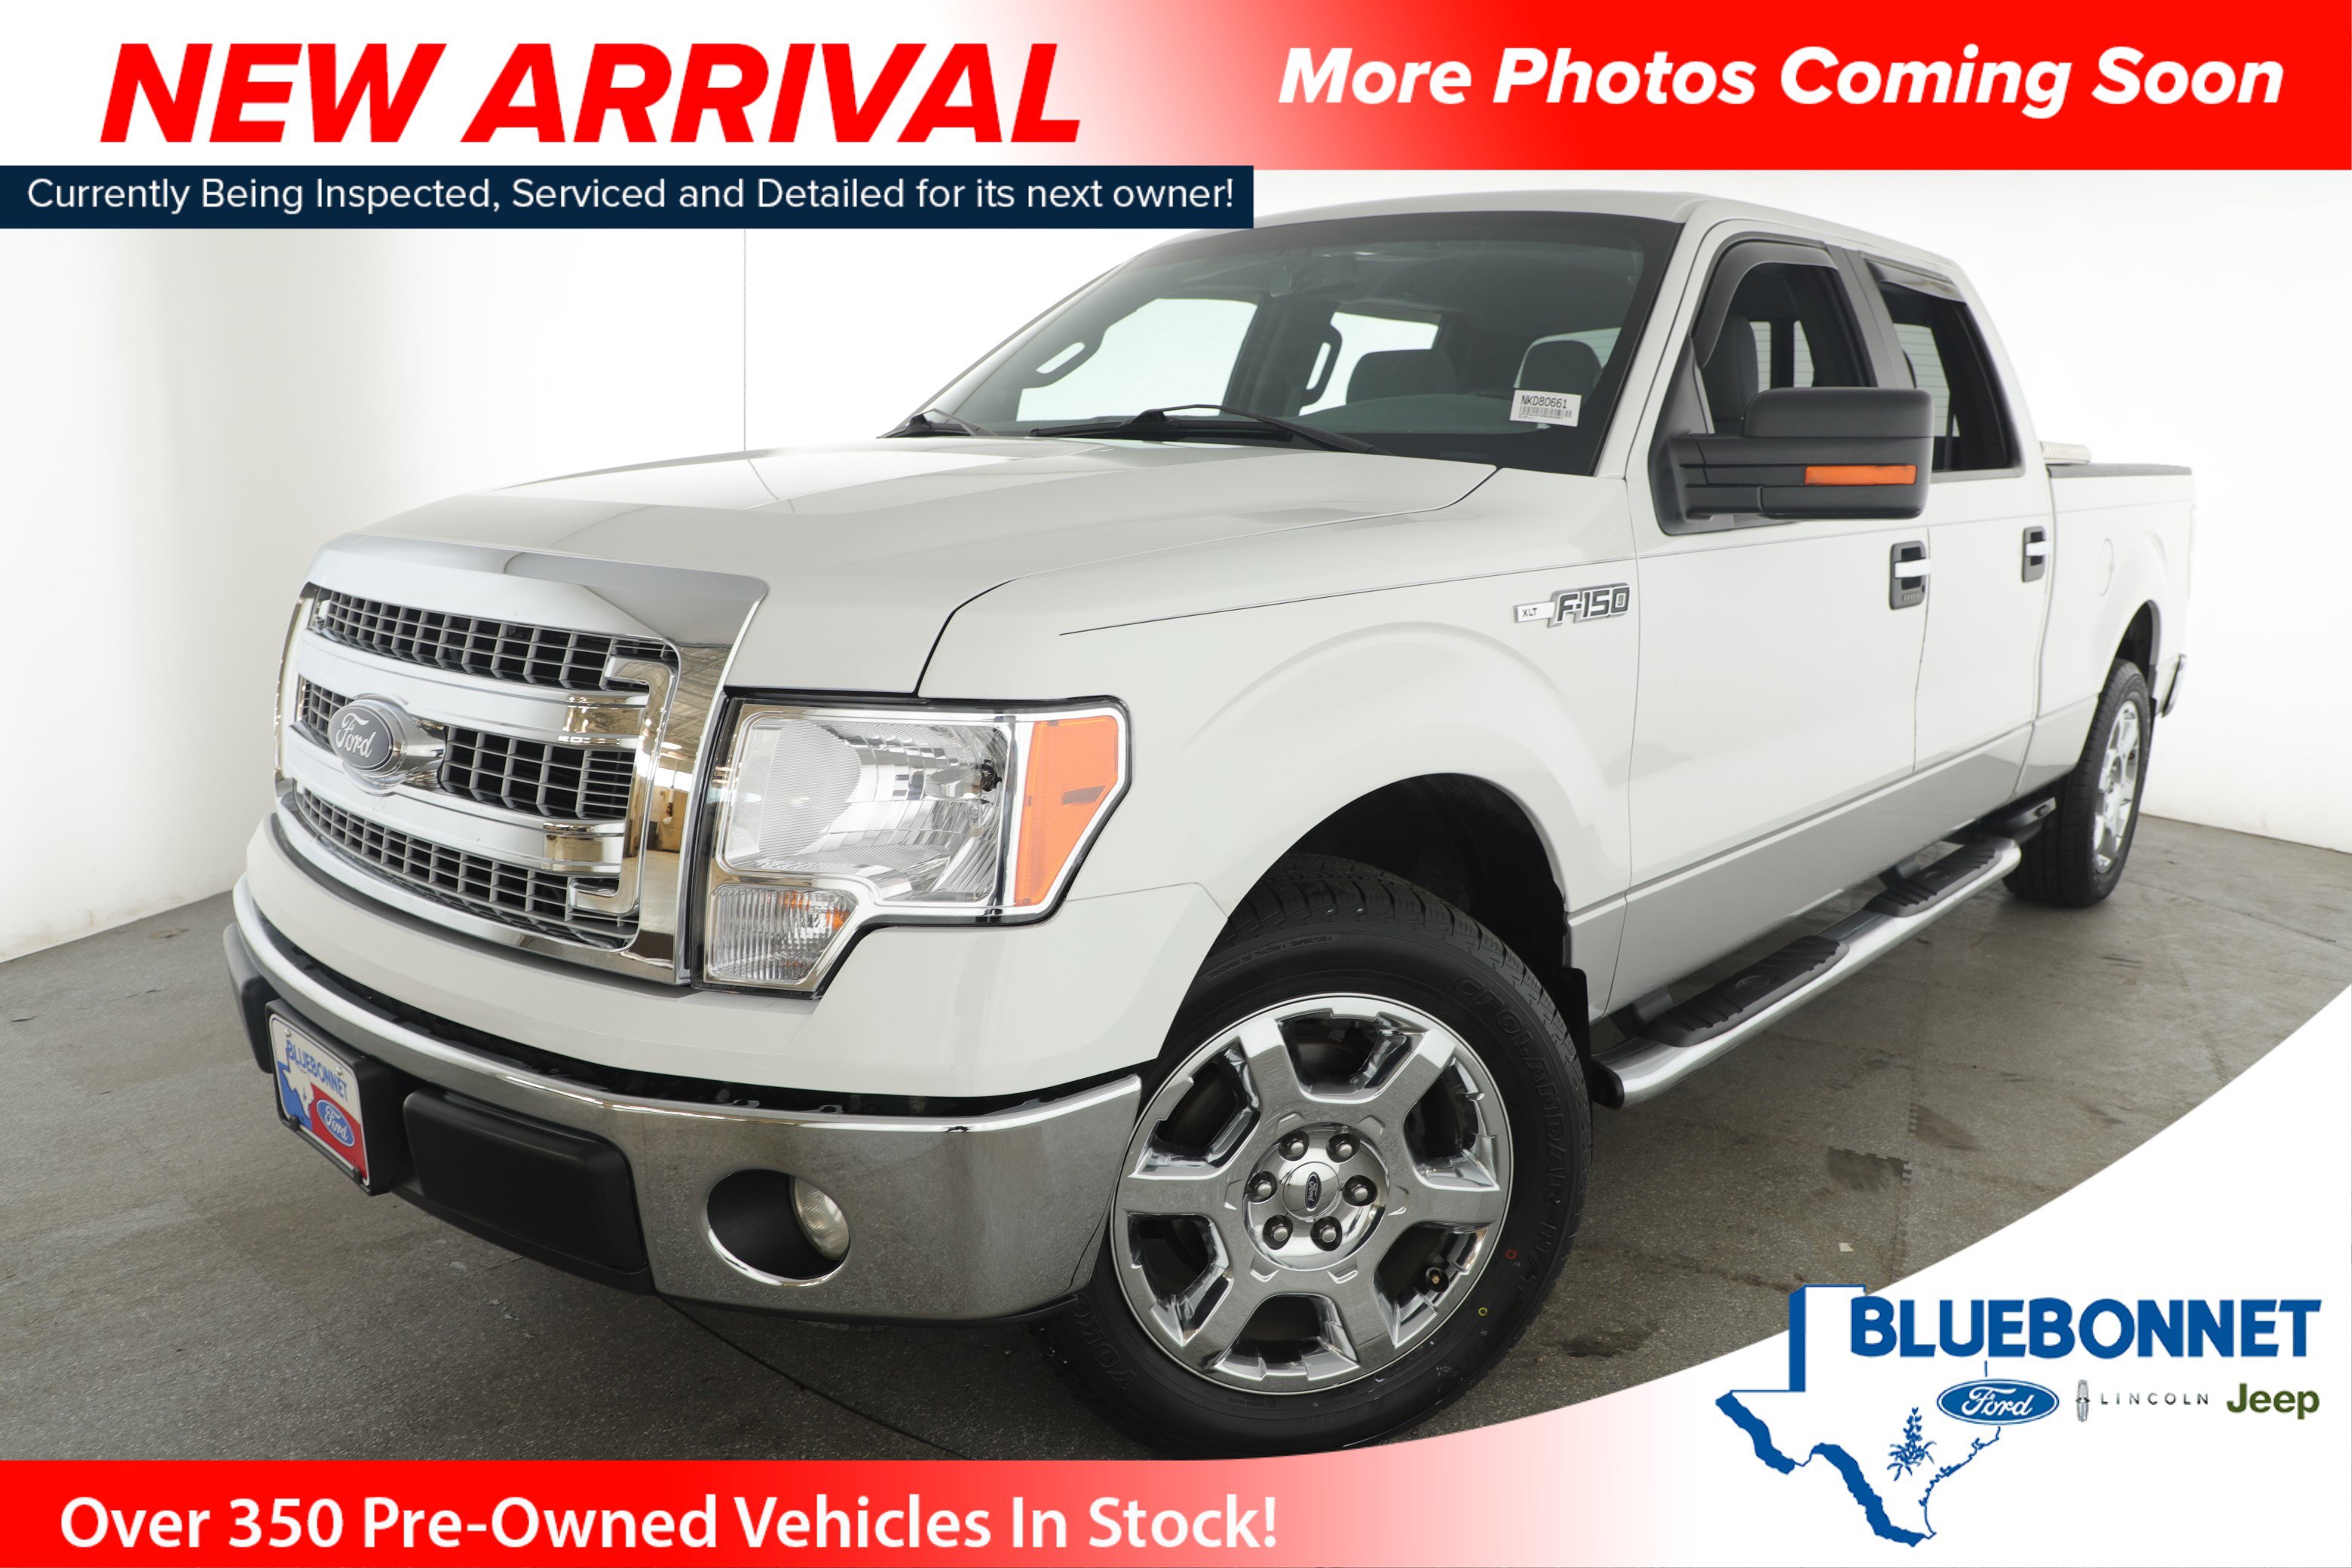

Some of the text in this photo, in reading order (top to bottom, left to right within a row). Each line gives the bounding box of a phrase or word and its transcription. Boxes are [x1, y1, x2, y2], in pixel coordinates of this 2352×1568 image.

[1521, 395, 1567, 409] NKD80661
[1522, 584, 1630, 626] XLT F-150
[336, 712, 377, 758] Ford
[286, 1040, 348, 1102] BLUEBONNET
[324, 1104, 349, 1141] Ford
[1308, 1181, 1318, 1202] Ford
